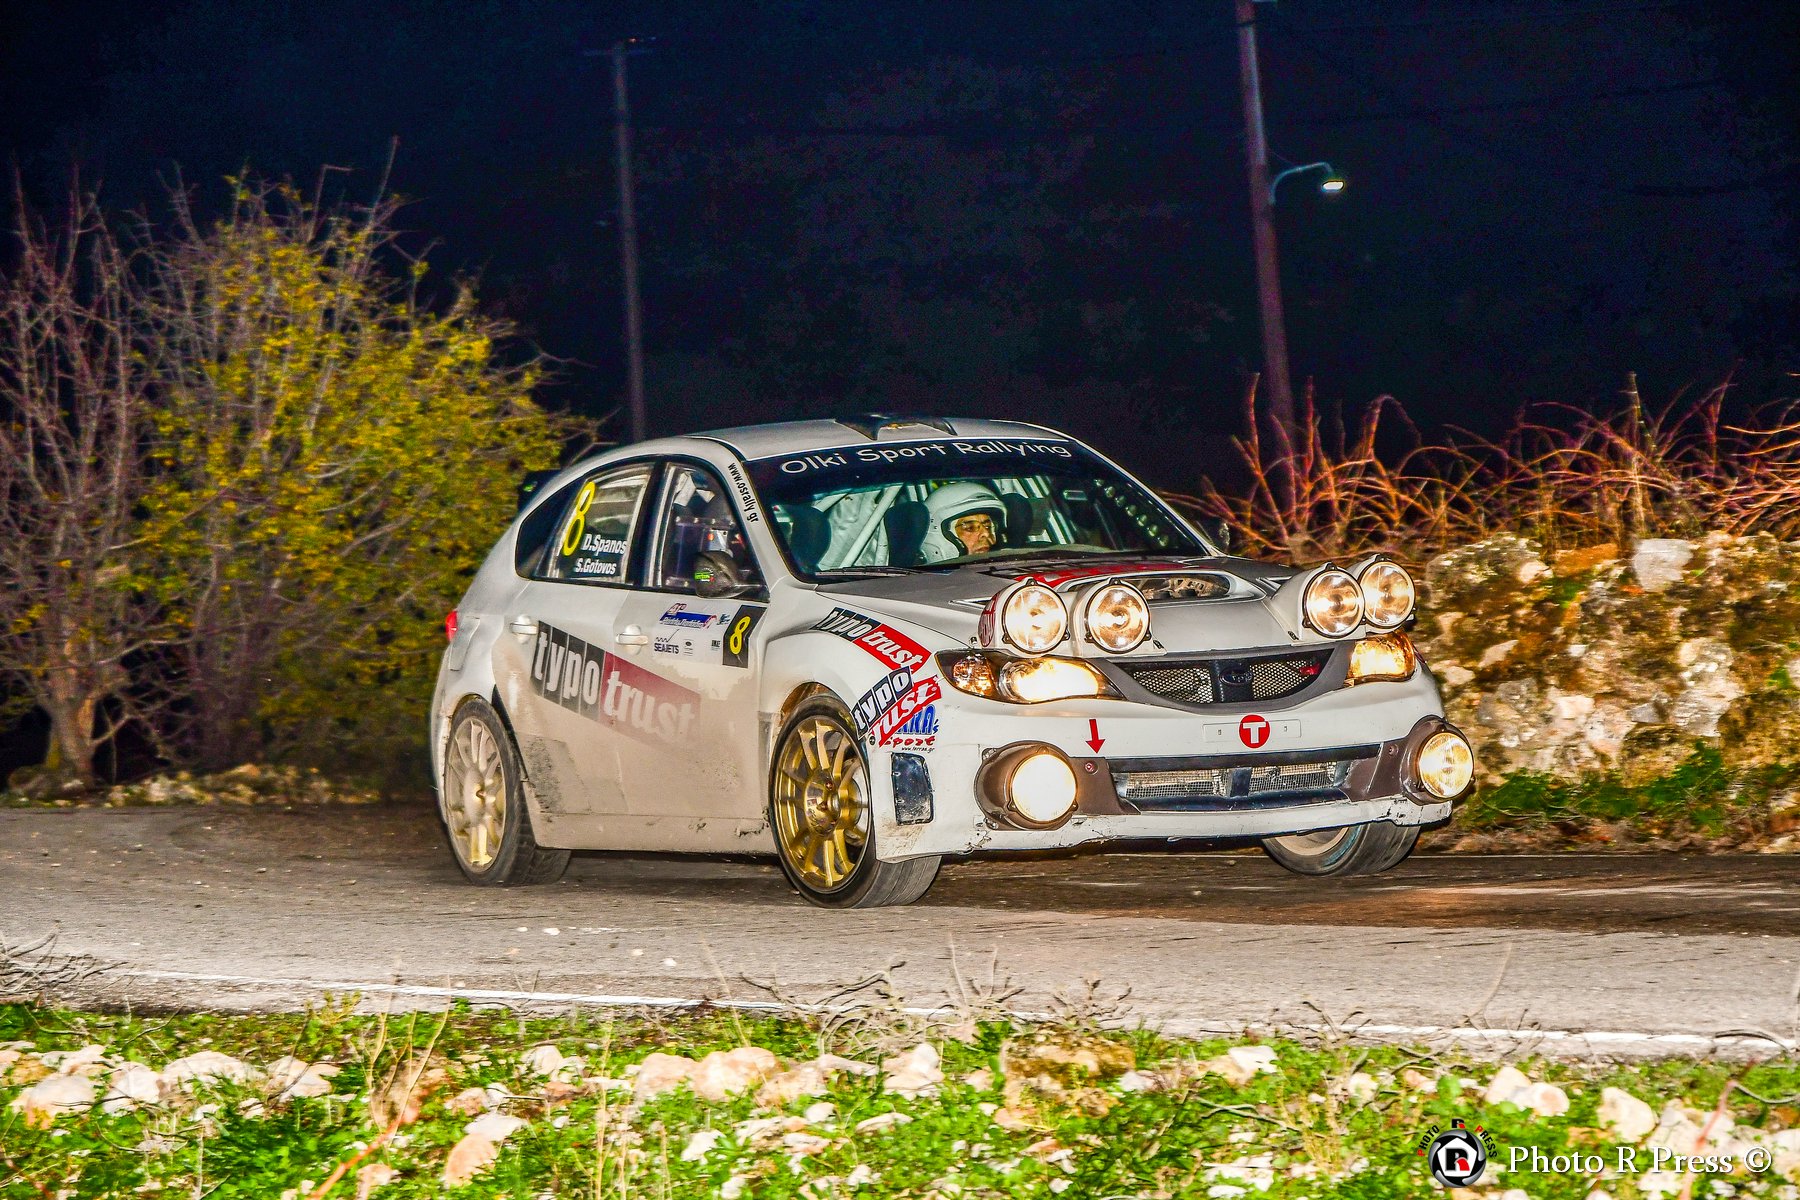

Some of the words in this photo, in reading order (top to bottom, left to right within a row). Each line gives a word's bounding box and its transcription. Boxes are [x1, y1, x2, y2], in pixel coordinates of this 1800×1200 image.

[780, 452, 847, 474] Olki
[855, 442, 947, 463] Sport
[952, 440, 1072, 458] Rallying
[563, 480, 596, 556] 8
[581, 533, 627, 556] D.Spanos
[575, 557, 617, 575] S.Gotovos
[729, 615, 751, 655] 8
[653, 642, 680, 655] SEAJETS
[1242, 721, 1267, 744] T
